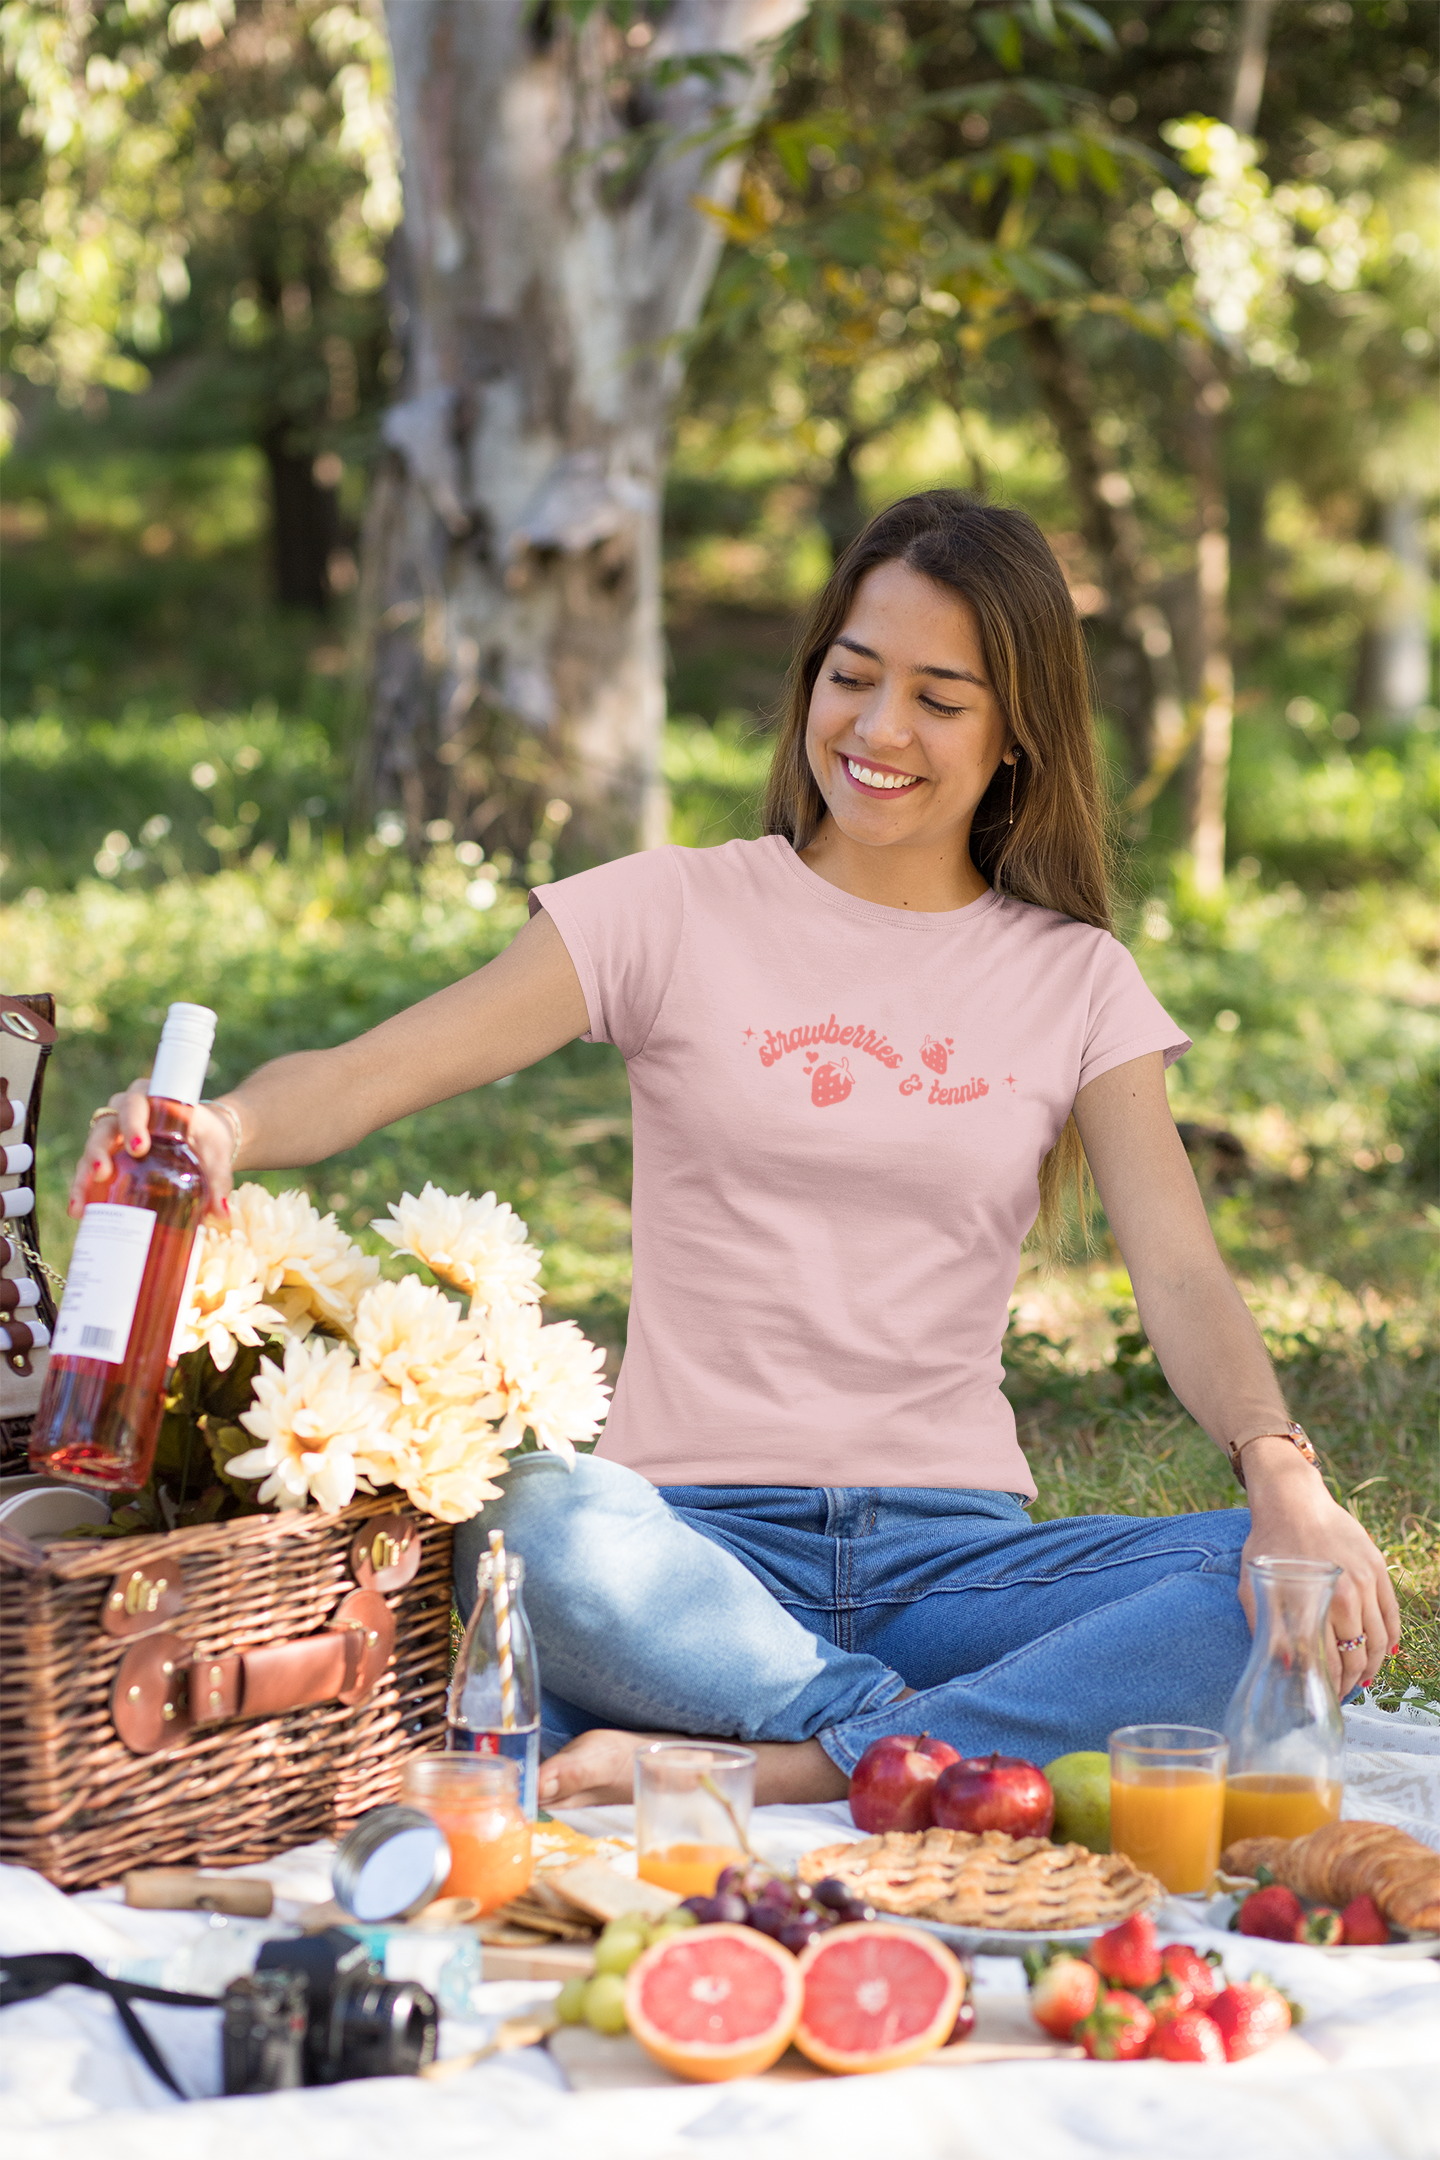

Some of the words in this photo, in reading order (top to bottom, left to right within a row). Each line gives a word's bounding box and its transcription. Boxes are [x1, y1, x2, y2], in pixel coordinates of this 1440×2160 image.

[758, 1013, 903, 1069] strawberries
[898, 1073, 923, 1096] &
[927, 1076, 990, 1105] tennis
